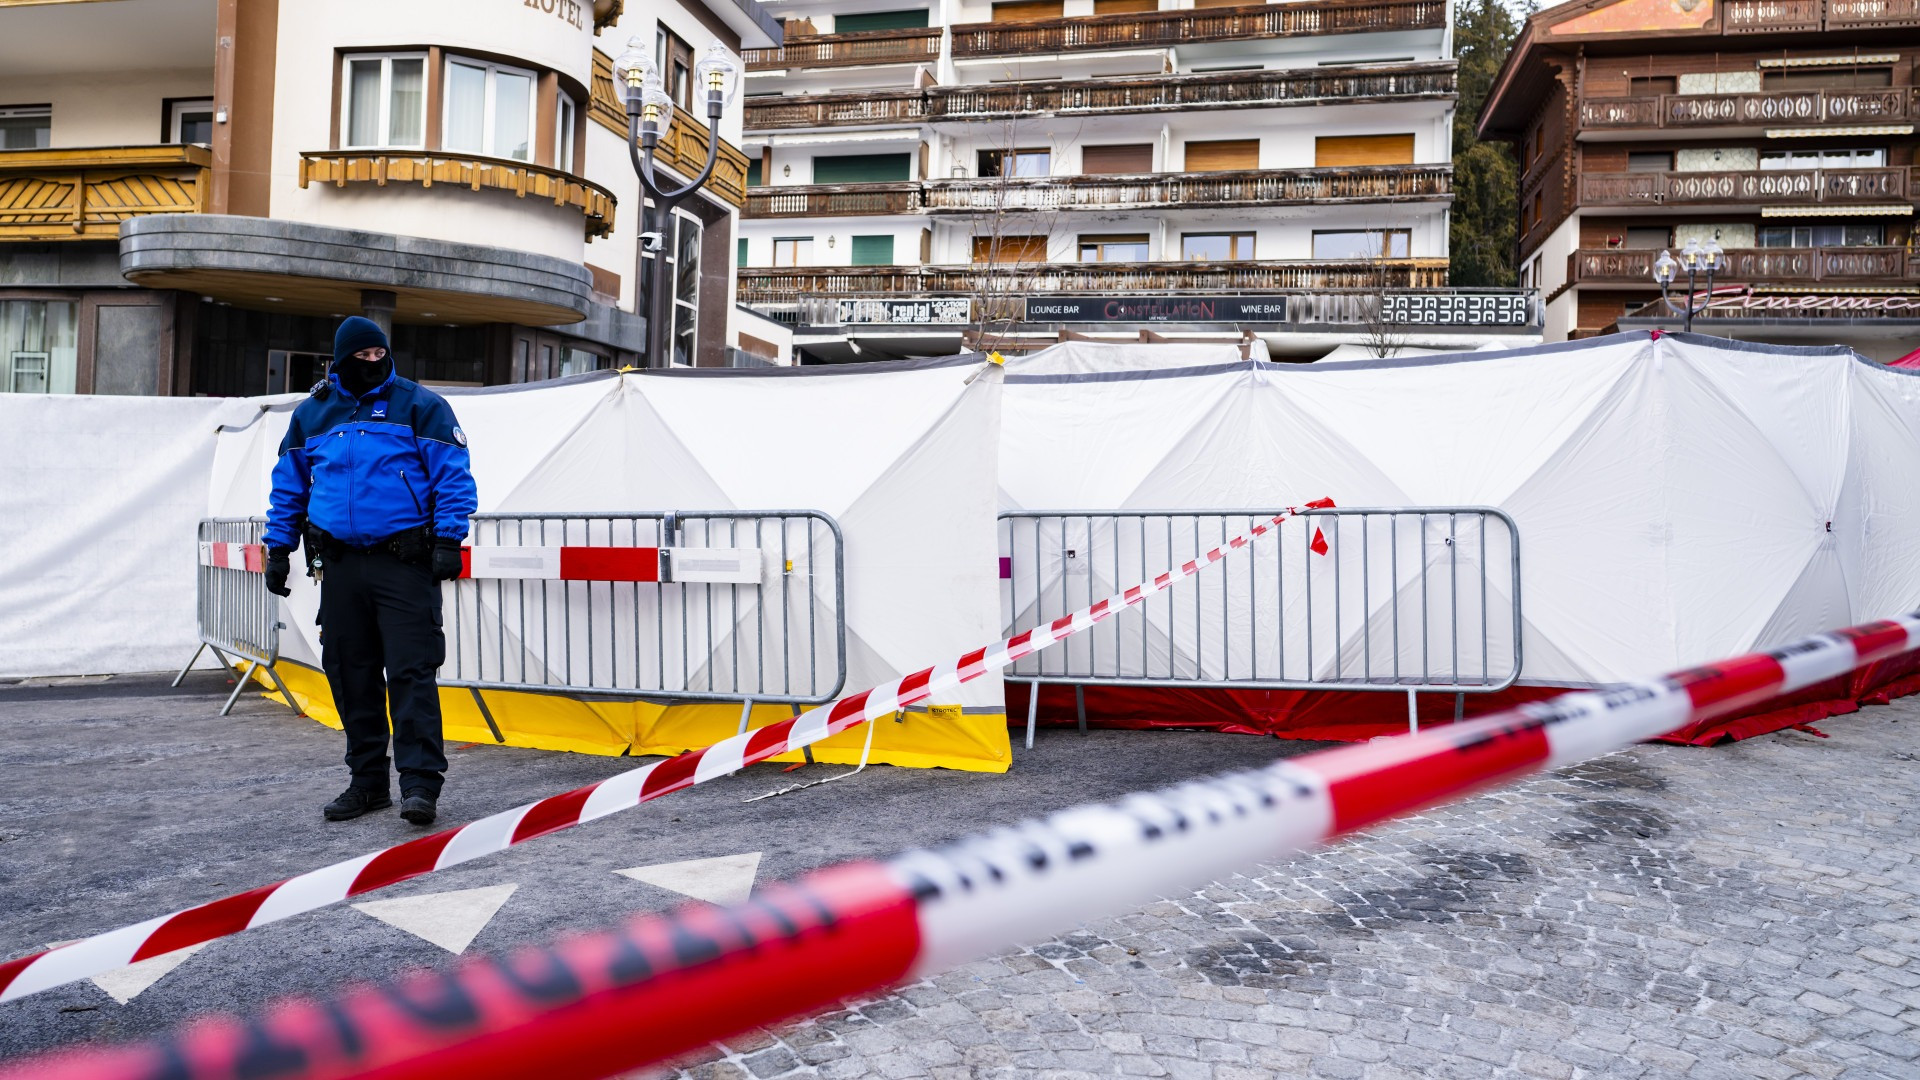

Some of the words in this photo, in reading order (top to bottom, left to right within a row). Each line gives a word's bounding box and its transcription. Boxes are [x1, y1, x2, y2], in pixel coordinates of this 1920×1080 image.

[892, 302, 930, 317] rental
[1030, 305, 1062, 314] LOUNGE
[1063, 305, 1080, 314] BAR
[1240, 304, 1262, 313] WINE
[1263, 304, 1281, 313] BAR
